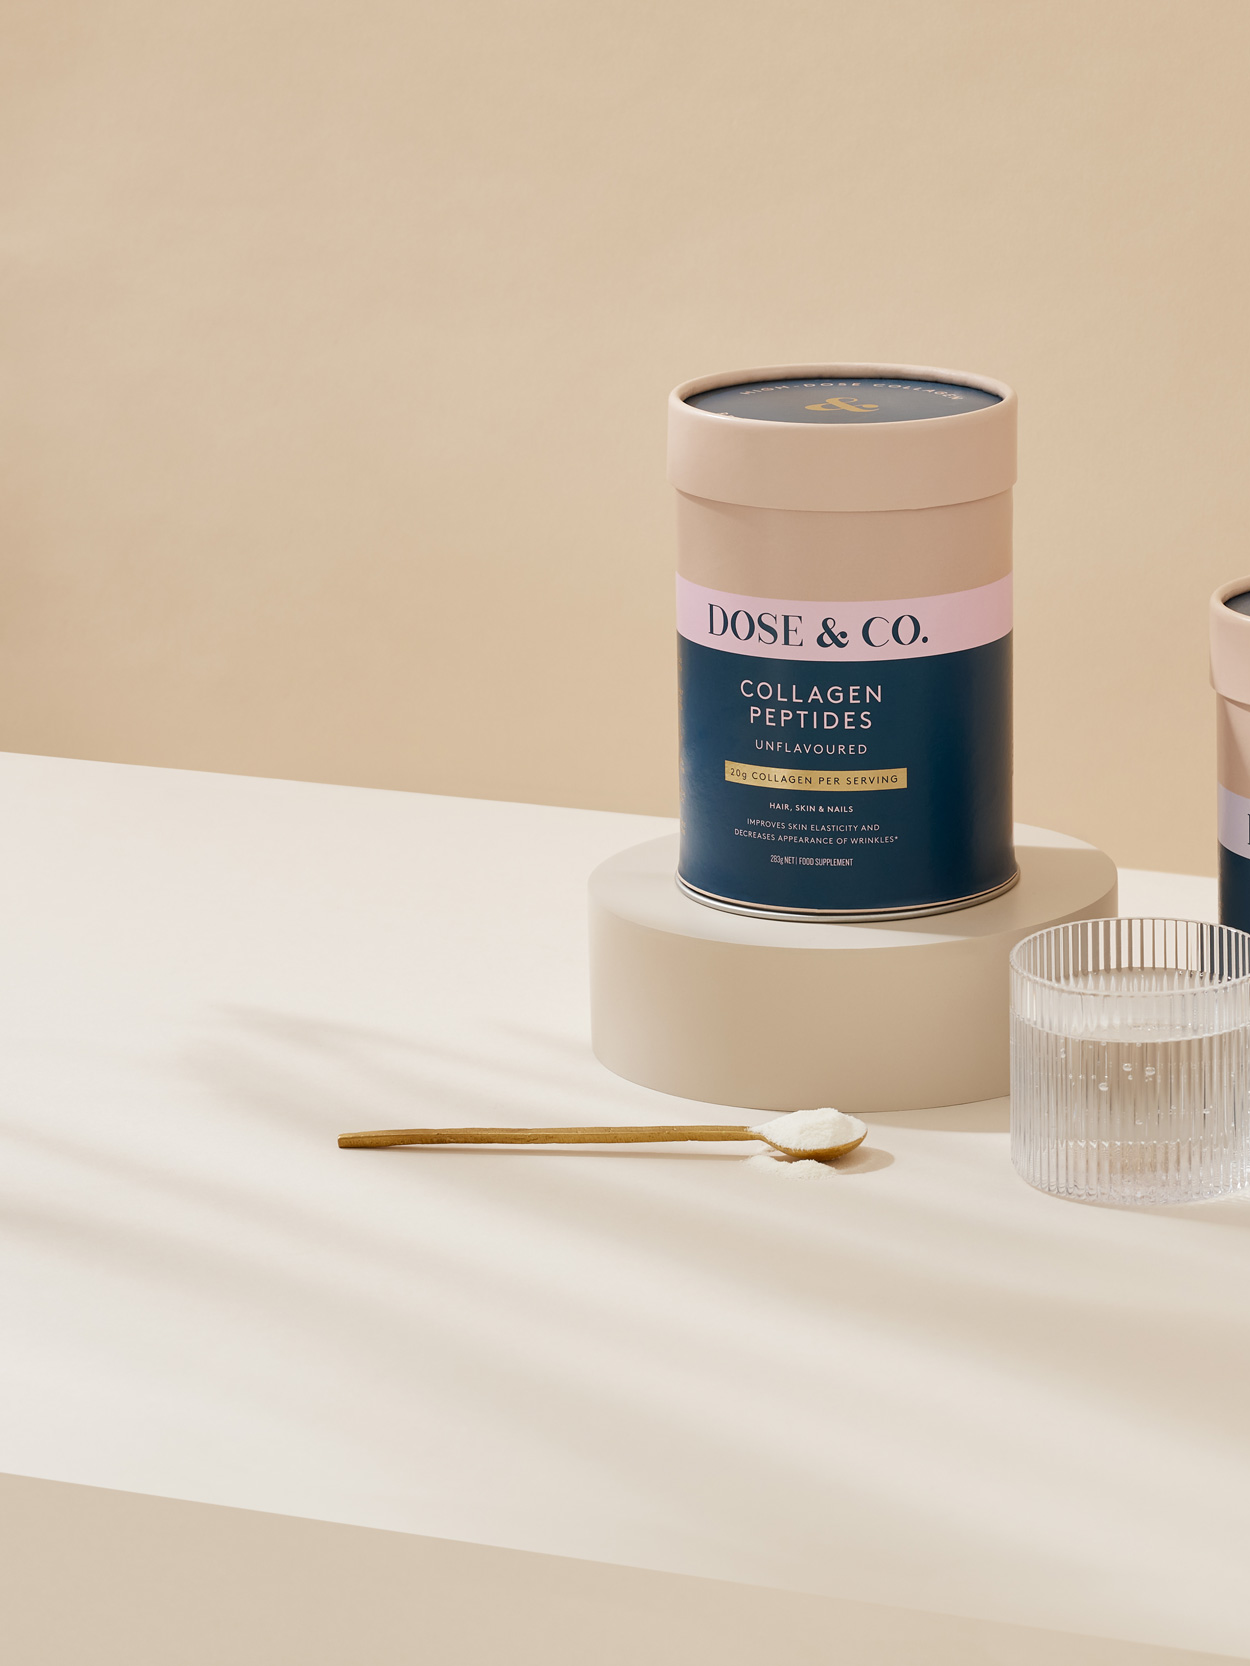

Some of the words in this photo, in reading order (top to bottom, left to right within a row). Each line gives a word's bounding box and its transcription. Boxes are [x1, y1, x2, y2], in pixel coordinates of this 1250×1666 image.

[805, 397, 879, 413] &
[708, 603, 803, 647] DOSE
[816, 617, 849, 648] &
[862, 614, 928, 647] CO.
[740, 679, 882, 703] COLLAGEN
[750, 706, 872, 729] PEPTIDES
[755, 739, 867, 755] UNFLAVOURED
[730, 768, 747, 780] 20g
[751, 771, 812, 785] COLLAGEN
[818, 777, 840, 785] PER
[846, 775, 898, 785] SERVING
[769, 802, 793, 812] HAIR,
[795, 804, 816, 812] SKIN
[747, 818, 786, 829] IMPROVES
[788, 823, 808, 831] SKIN
[810, 824, 858, 832] ELASTICITY
[734, 828, 775, 841] DECREASES
[778, 835, 833, 845] APPEARANCE
[836, 837, 848, 845] OF
[770, 854, 784, 865] 283g
[798, 857, 814, 866] FOOD
[815, 858, 853, 867] SUPPLEMENT
